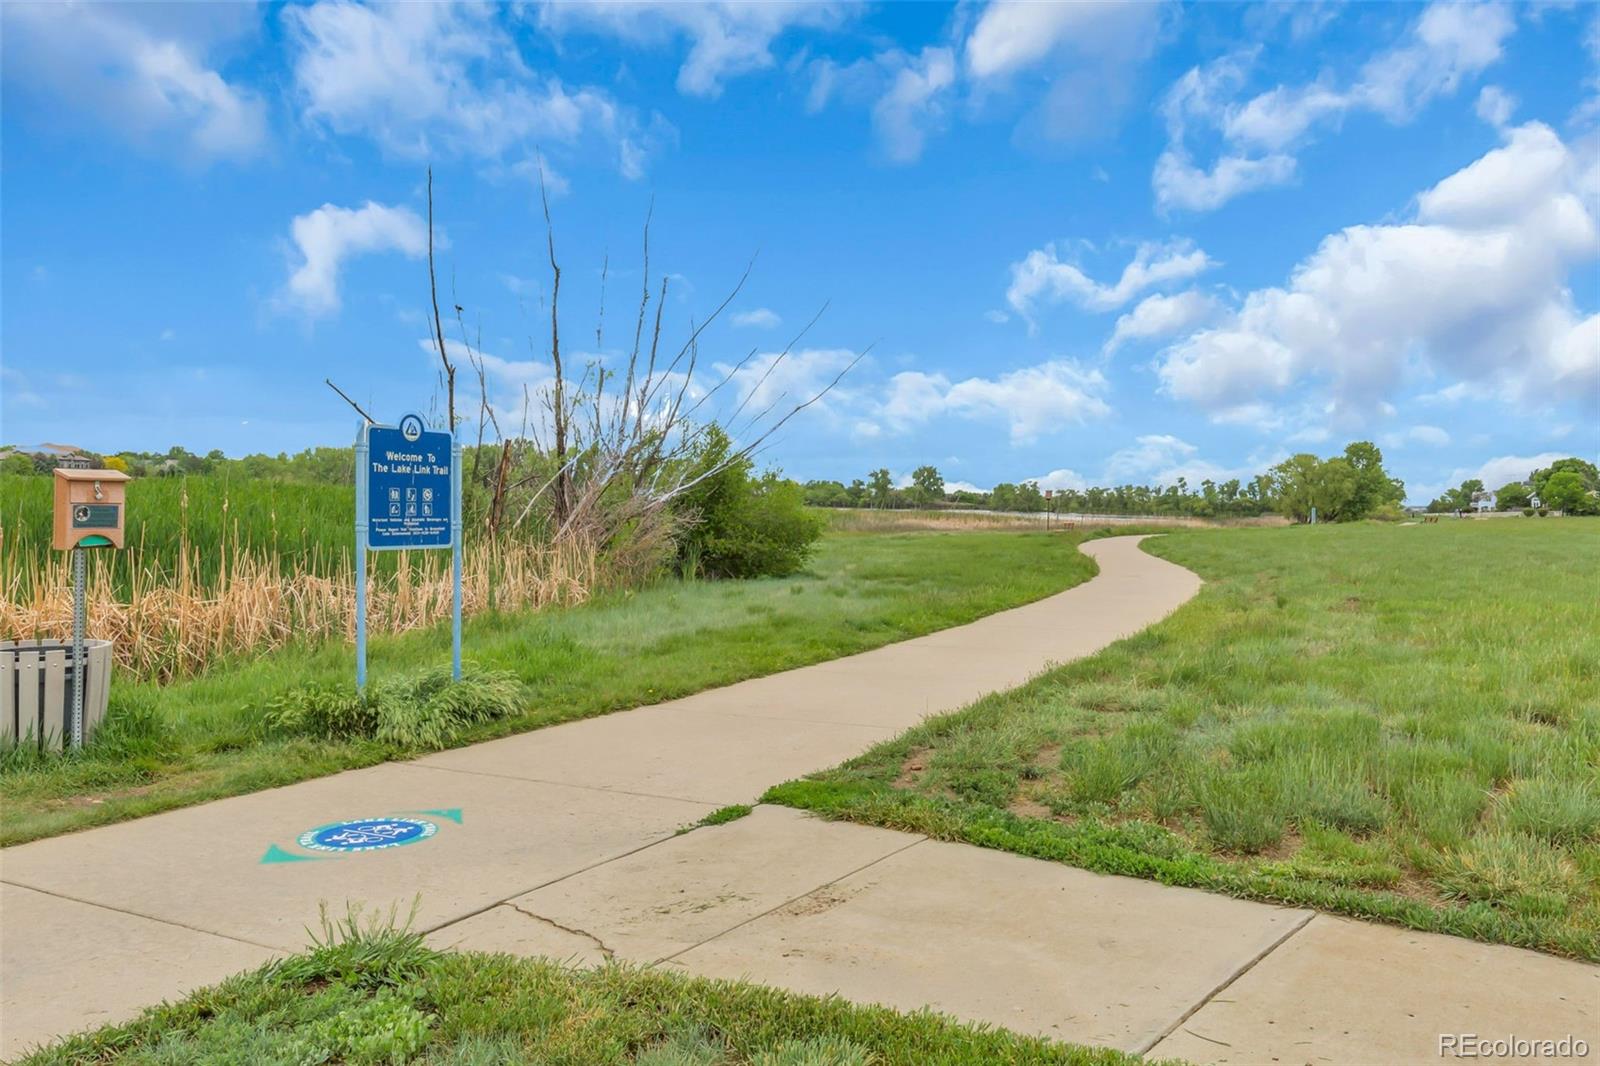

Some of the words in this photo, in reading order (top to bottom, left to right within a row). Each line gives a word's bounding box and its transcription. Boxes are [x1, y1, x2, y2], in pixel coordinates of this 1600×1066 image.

[386, 451, 423, 462] Welcome
[427, 453, 436, 463] To
[372, 462, 388, 473] The
[391, 463, 412, 474] Lake
[414, 464, 431, 475] Link
[432, 465, 449, 475] Trail
